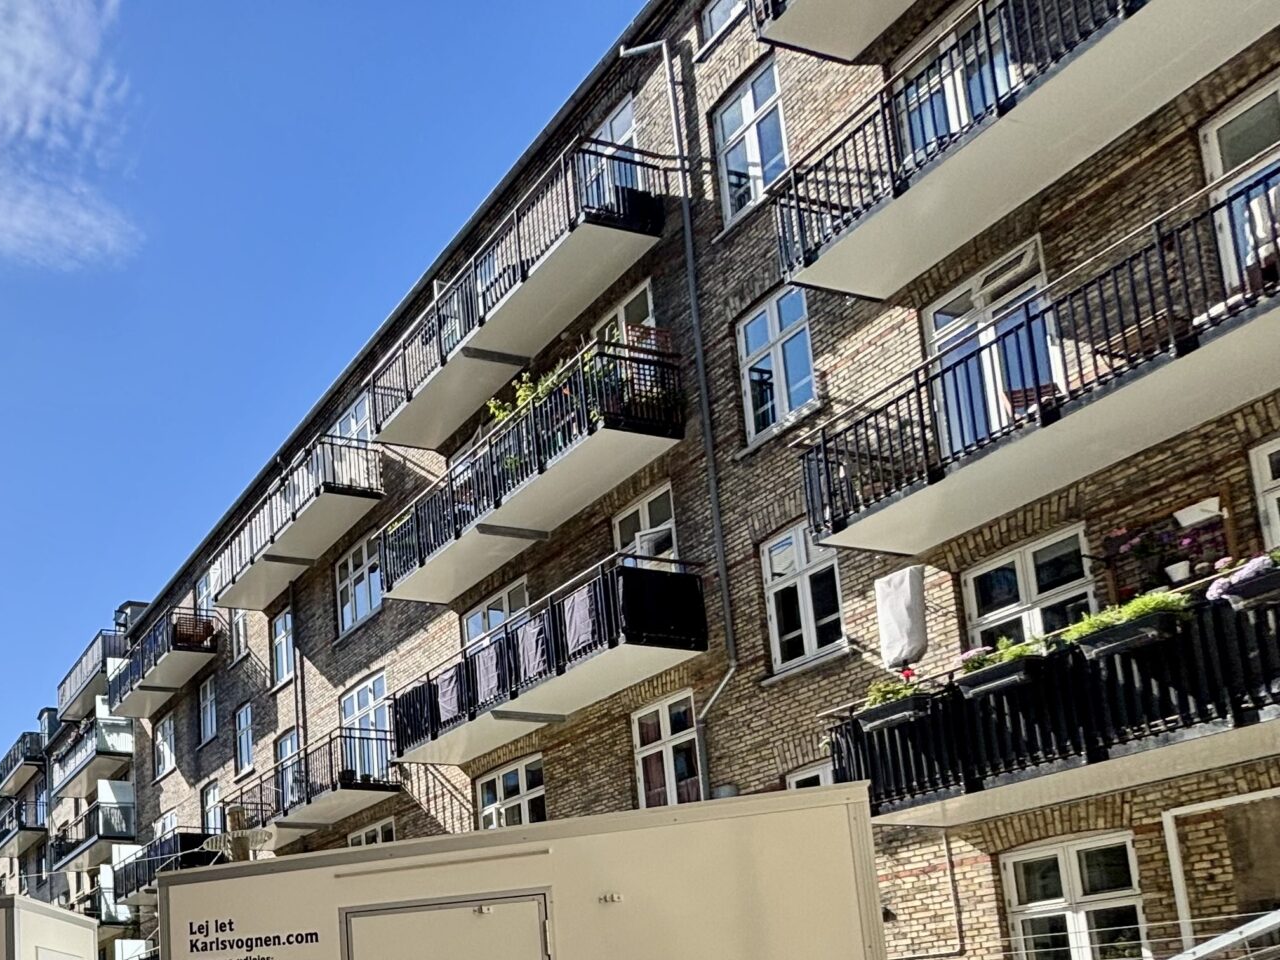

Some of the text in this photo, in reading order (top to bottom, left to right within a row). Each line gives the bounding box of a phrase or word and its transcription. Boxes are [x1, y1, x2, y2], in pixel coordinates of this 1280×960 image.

[189, 918, 234, 937] Lej let
[189, 931, 319, 953] Karlsvognen.com
